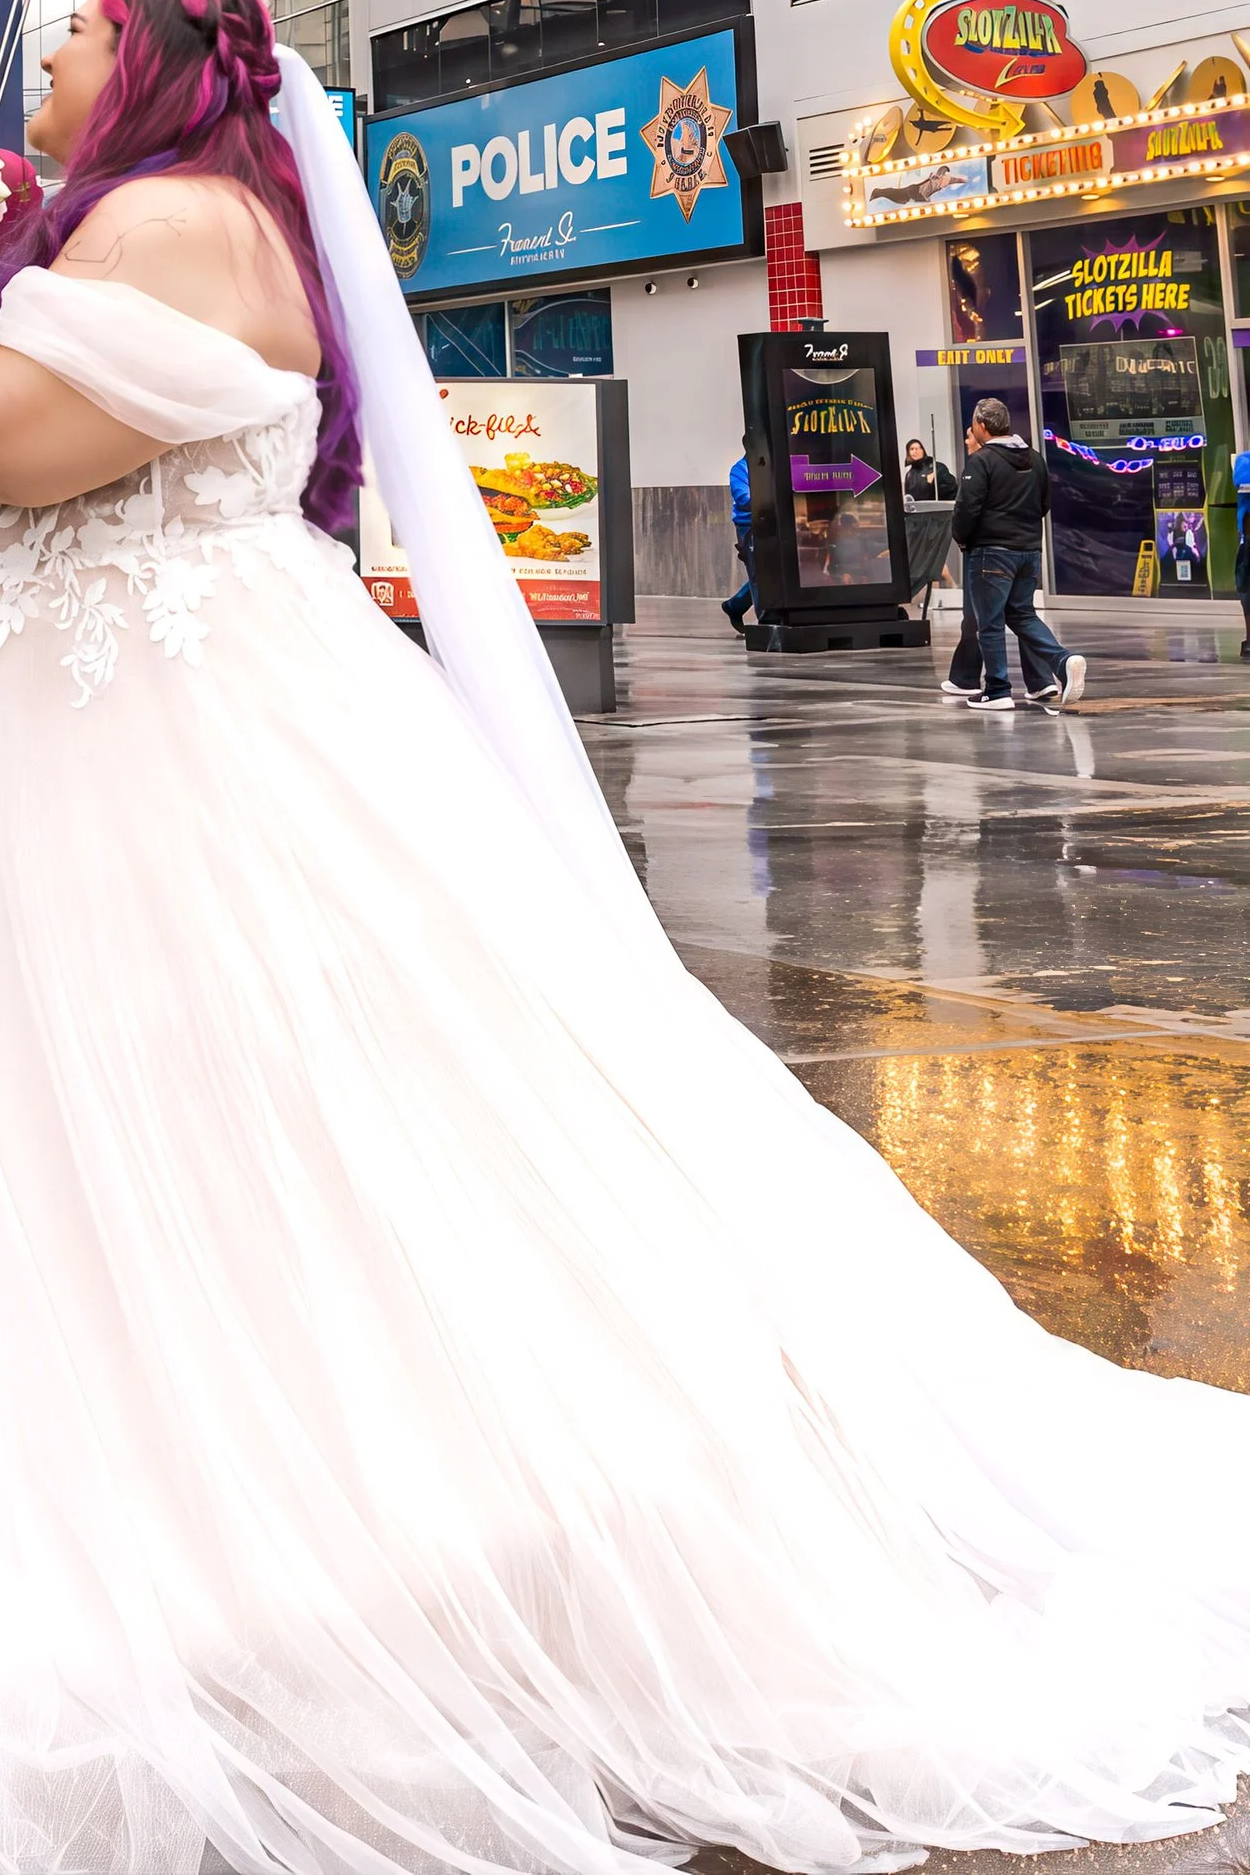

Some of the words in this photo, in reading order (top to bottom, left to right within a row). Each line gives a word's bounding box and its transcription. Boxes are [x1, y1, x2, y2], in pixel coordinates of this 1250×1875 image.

[452, 107, 628, 208] POLICE
[1070, 250, 1173, 289] SLOTZILLA
[1065, 286, 1138, 321] TICKETS
[1141, 282, 1191, 311] HERE
